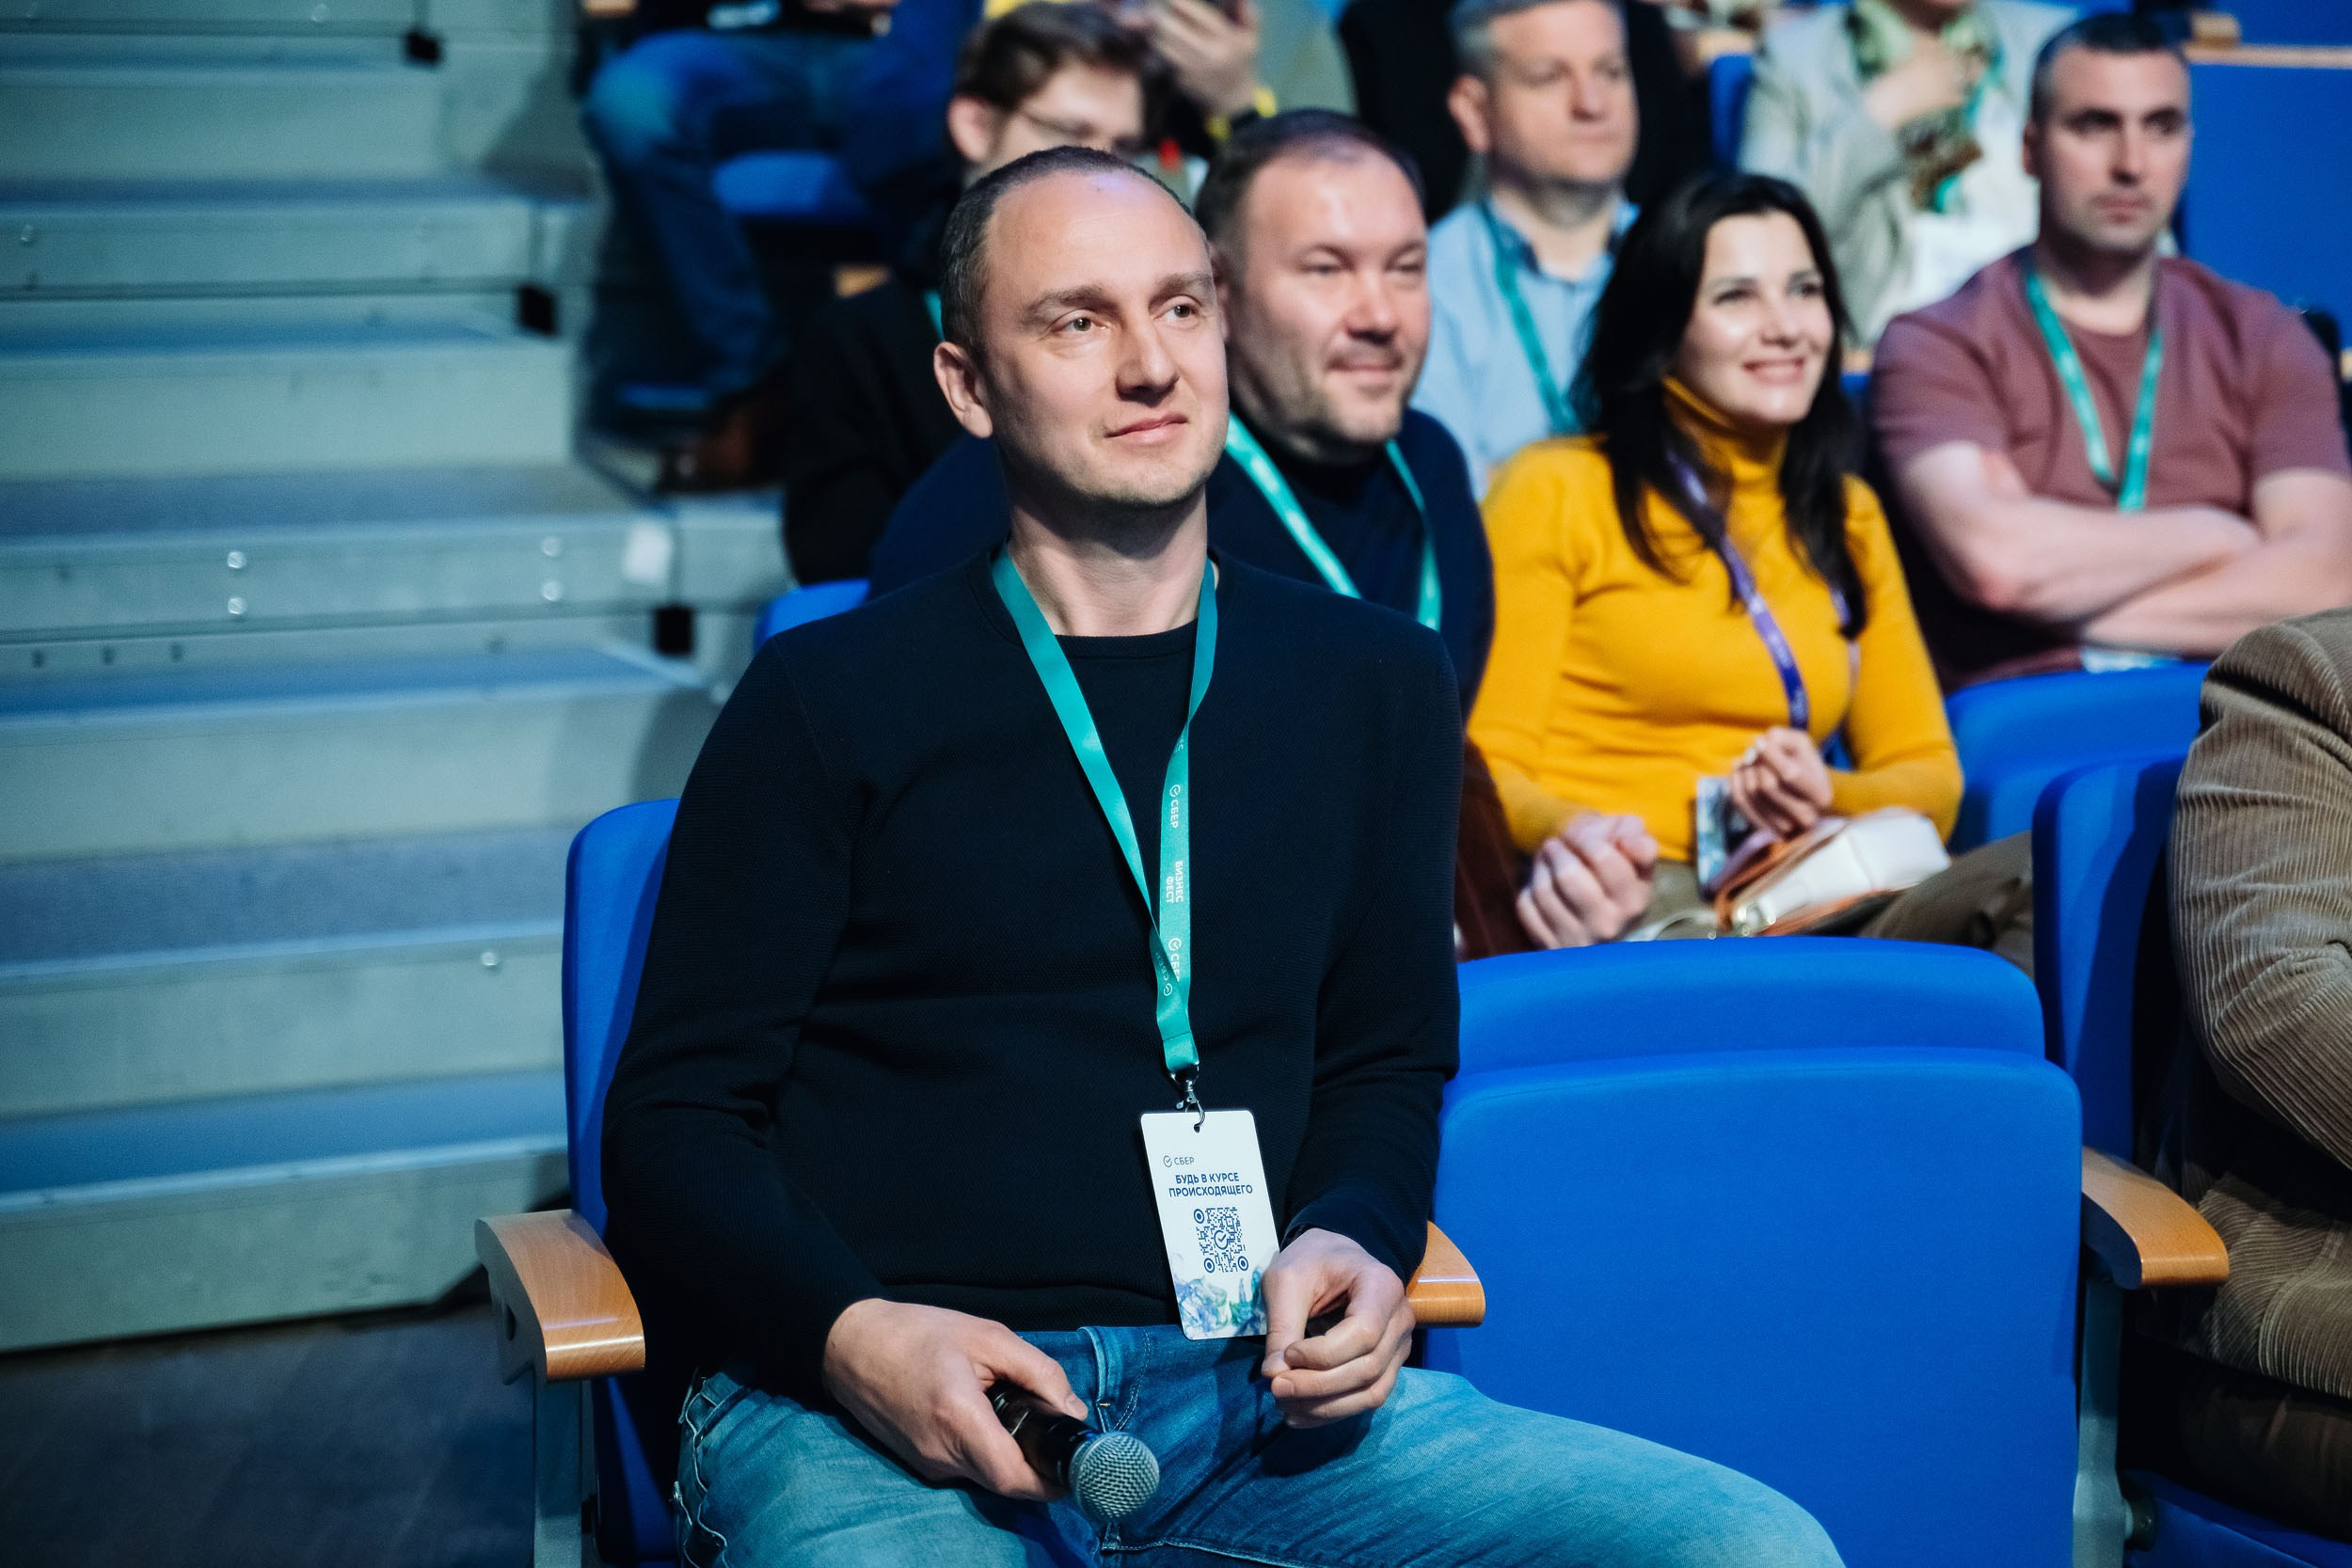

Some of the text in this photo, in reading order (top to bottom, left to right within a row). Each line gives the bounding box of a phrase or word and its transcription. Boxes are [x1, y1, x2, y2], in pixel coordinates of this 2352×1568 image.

[1170, 800, 1179, 829] СБЕР
[1175, 861, 1184, 903] БИЗНЕС
[1170, 953, 1180, 982] СБЕ
[1174, 1156, 1195, 1165] СБЕР
[1175, 1172, 1239, 1185] БУДЬ В КУРСЕ
[1168, 1184, 1253, 1197] ПРОИСХОДЯЩЕГО
